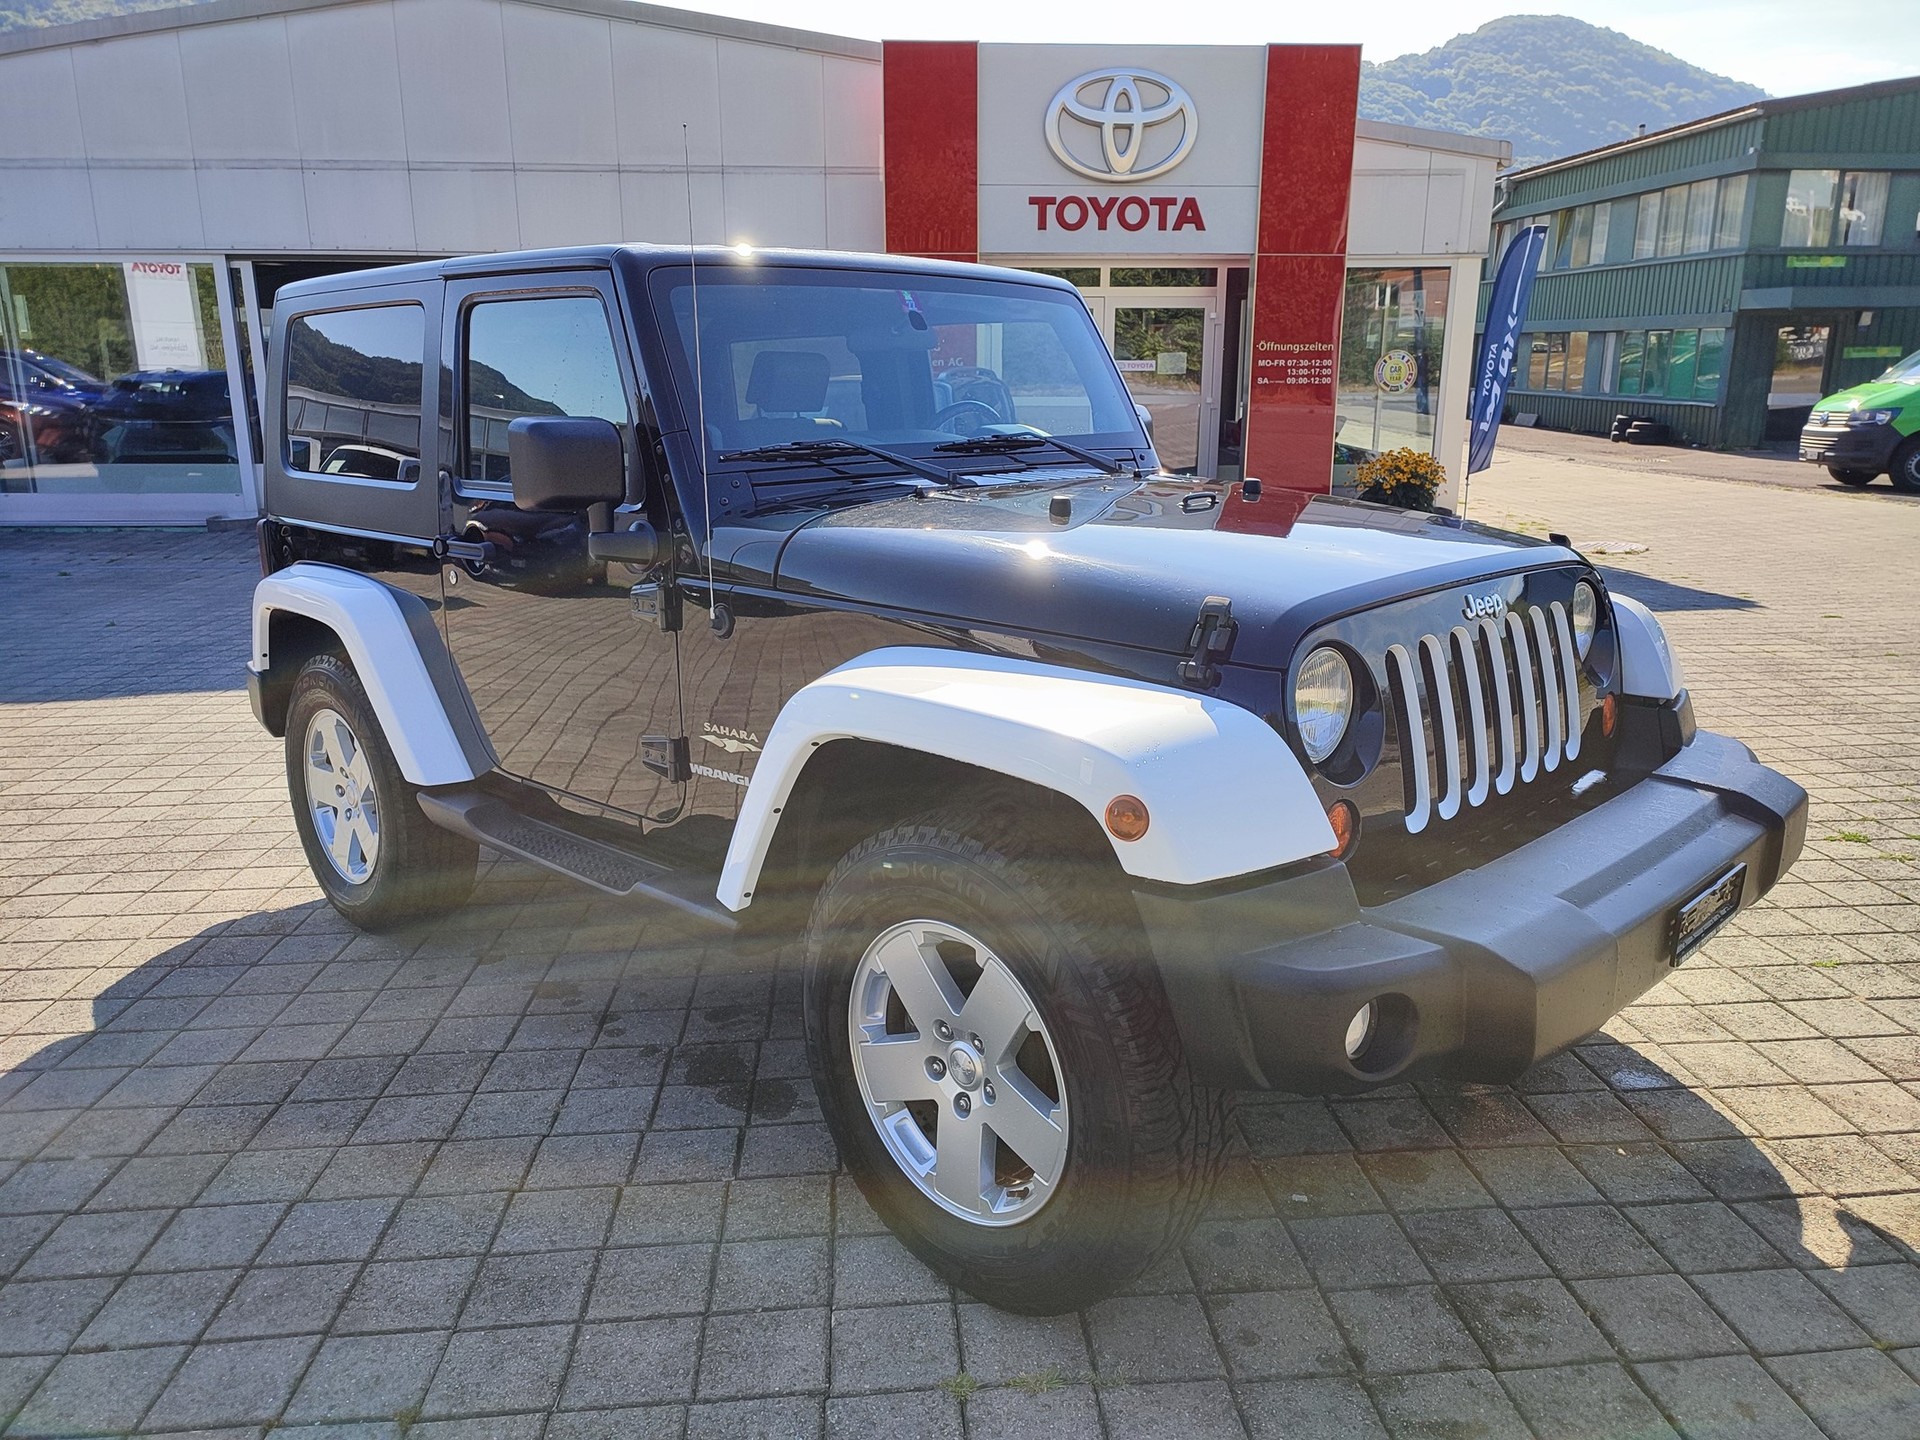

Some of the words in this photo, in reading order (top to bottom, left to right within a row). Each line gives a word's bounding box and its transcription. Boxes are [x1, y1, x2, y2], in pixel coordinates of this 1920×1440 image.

[1028, 195, 1206, 232] TOYOTA
[1258, 340, 1334, 354] Öffnungszeiten
[931, 359, 944, 367] en
[947, 357, 964, 367] AG
[1258, 359, 1286, 367] MO-FR
[1287, 359, 1332, 367] 07:30-12:00
[1389, 365, 1402, 373] CAR
[1287, 368, 1332, 376] 13:00-17:00
[1482, 343, 1498, 396] TOYOTA
[1257, 377, 1269, 385] SA
[1286, 377, 1331, 385] 09:00-12:00
[1462, 593, 1503, 620] Jeep
[703, 722, 759, 743] SAHARA
[689, 763, 750, 787] WRANGL
